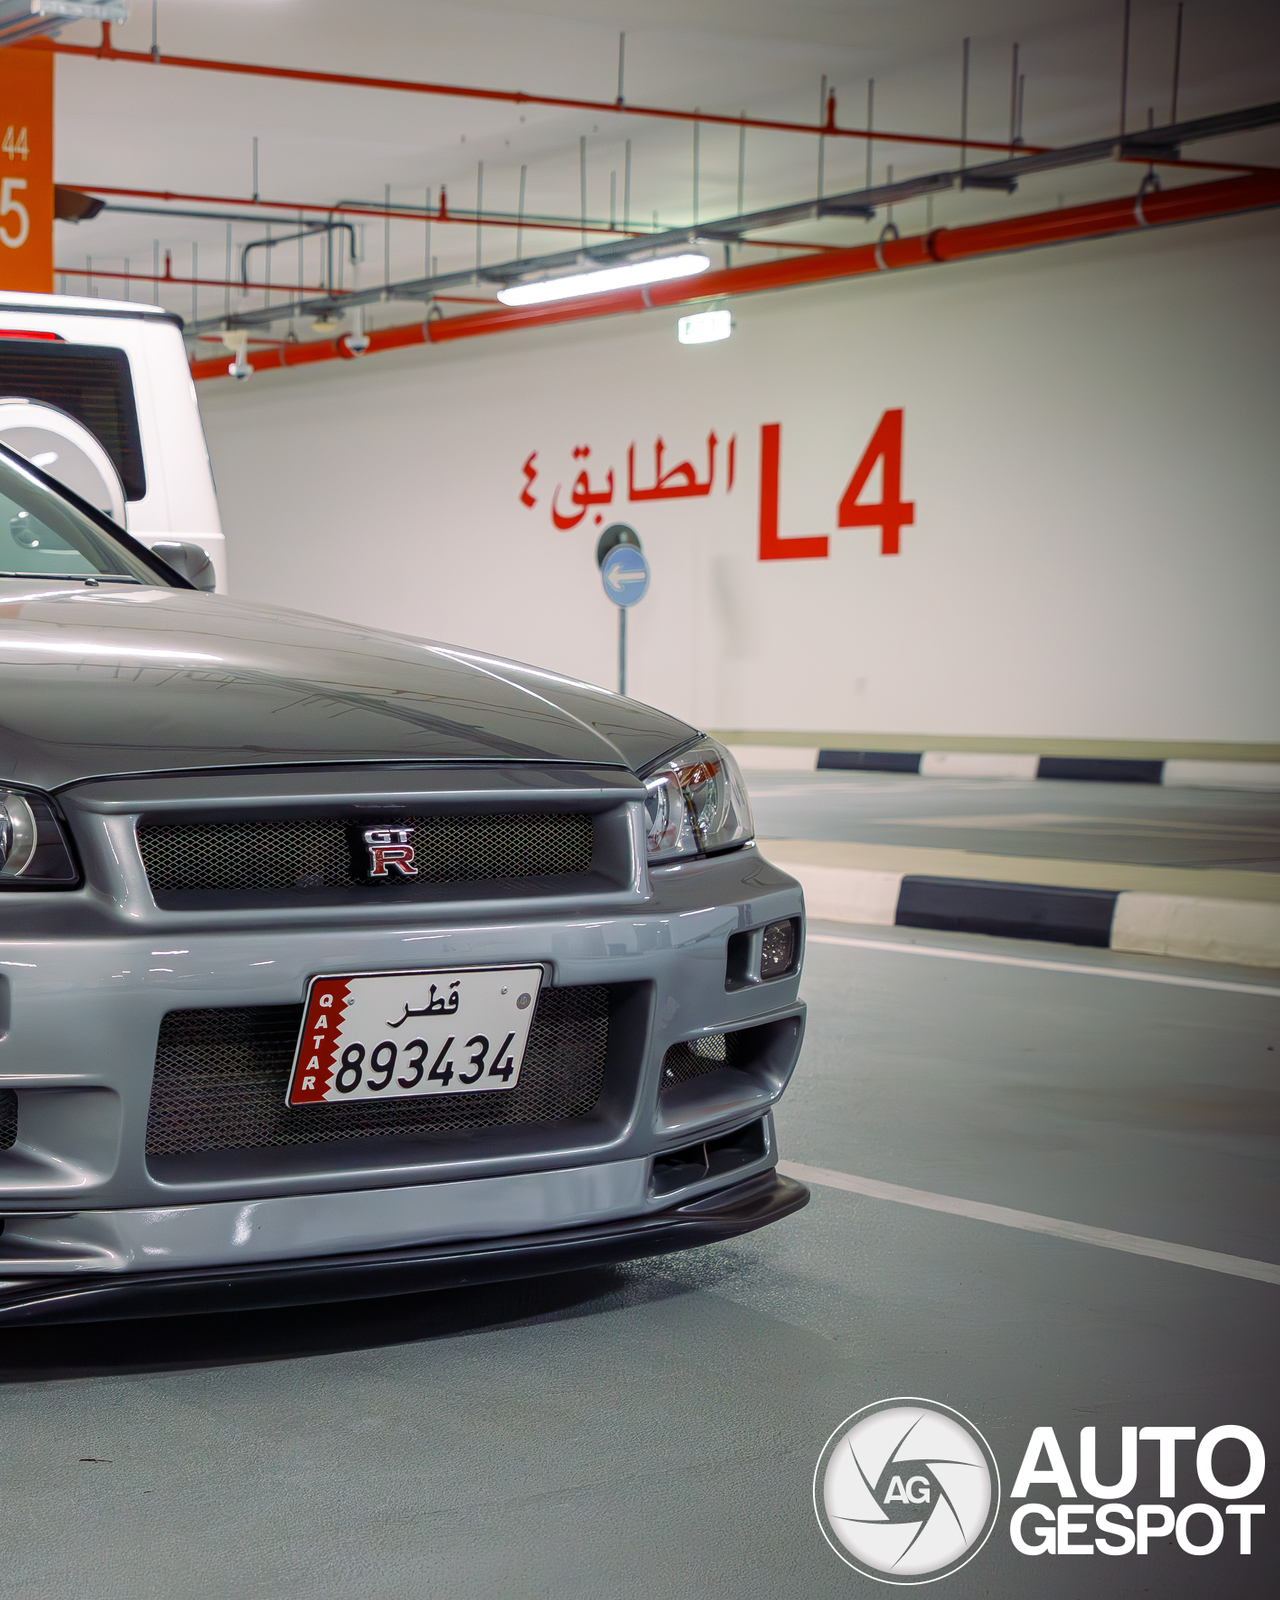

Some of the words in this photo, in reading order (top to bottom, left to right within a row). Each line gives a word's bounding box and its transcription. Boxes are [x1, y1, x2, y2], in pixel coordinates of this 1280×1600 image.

[1, 124, 29, 161] 44
[519, 449, 539, 509] ٤
[551, 427, 736, 531] الطابق
[757, 406, 915, 562] L4
[364, 828, 415, 844] GT
[368, 844, 419, 877] R
[386, 980, 461, 1029] قطر
[301, 993, 334, 1091] QATAR
[335, 1031, 516, 1094] 893434
